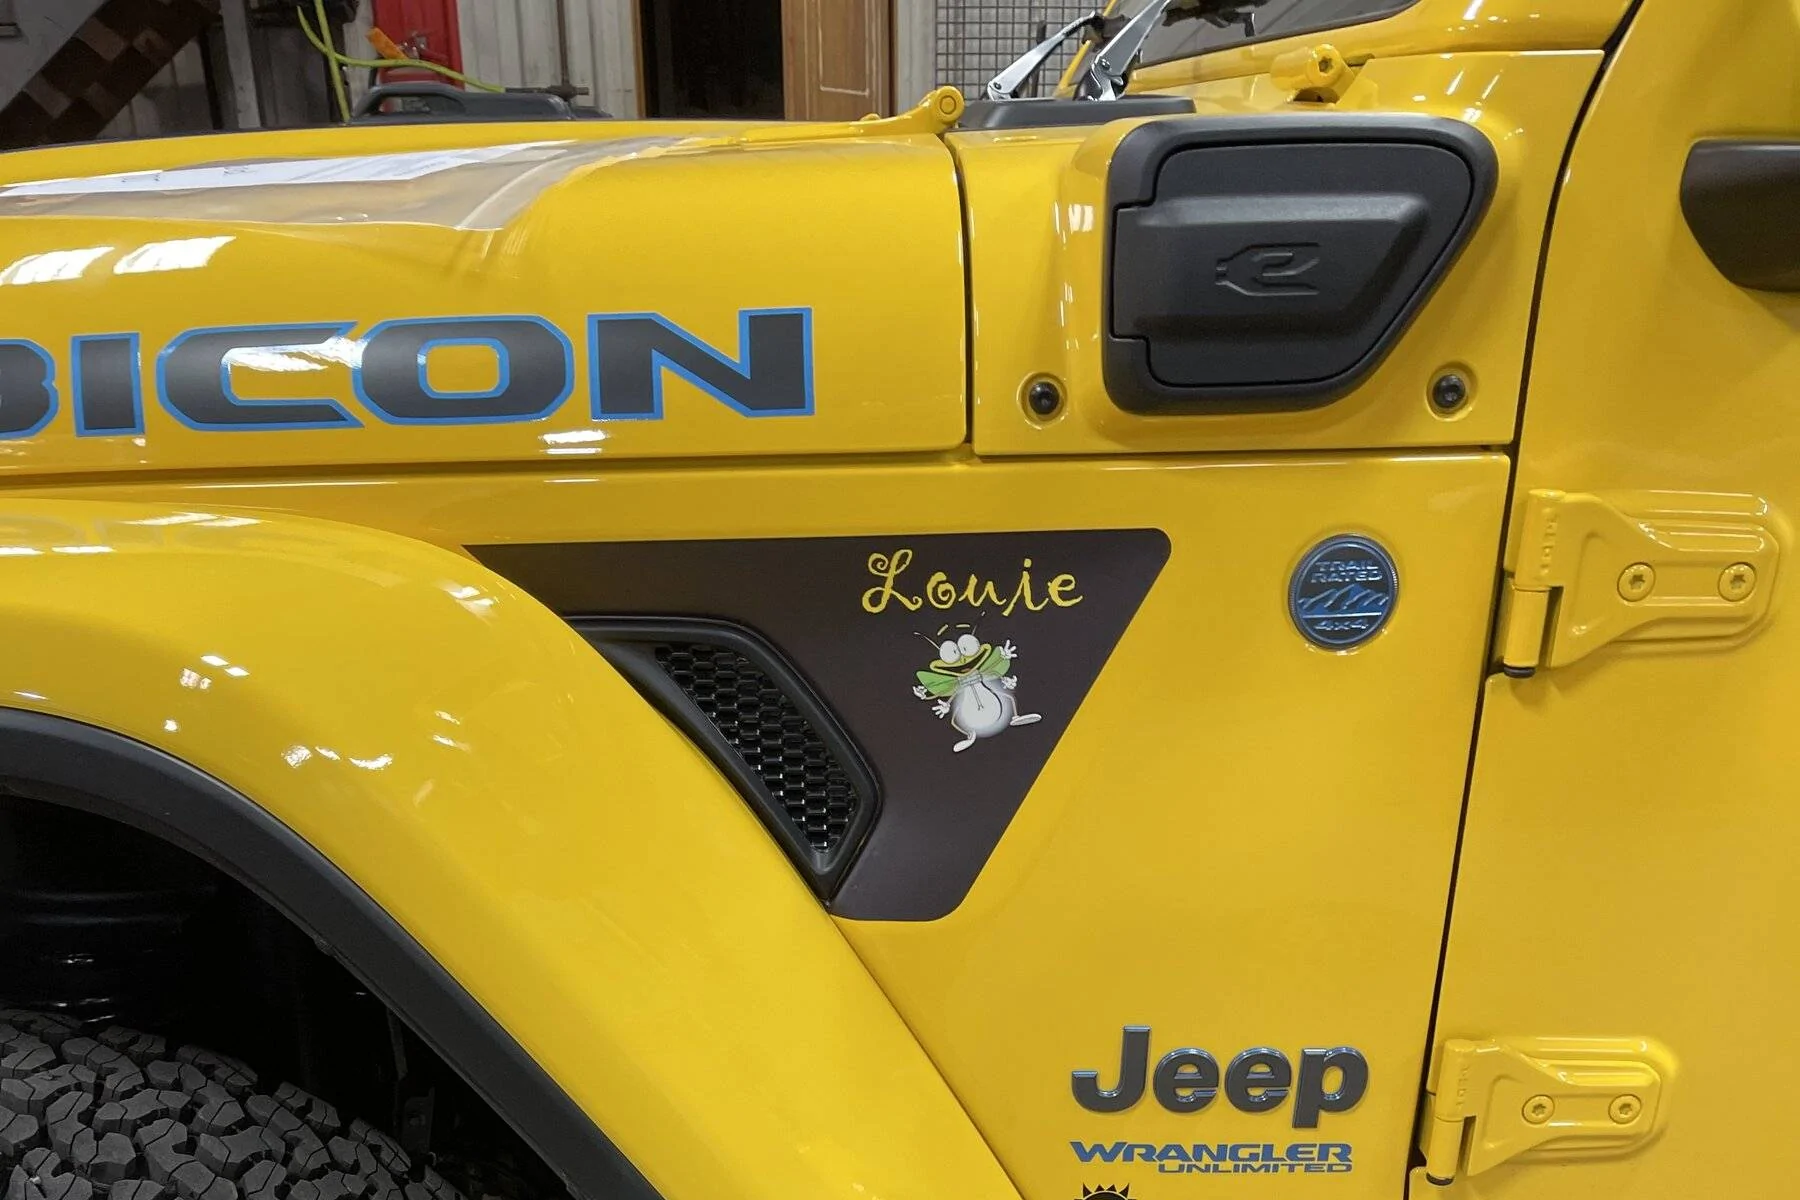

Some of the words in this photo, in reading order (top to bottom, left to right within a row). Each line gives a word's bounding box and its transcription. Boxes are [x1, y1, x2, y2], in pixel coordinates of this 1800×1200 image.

[1315, 560, 1379, 571] TRAIL
[862, 549, 1083, 616] Louie
[1311, 571, 1383, 583] RATED
[1071, 1025, 1369, 1129] Jeep
[1070, 1141, 1352, 1163] WRANGLER
[1158, 1163, 1352, 1174] UNLIMITED
